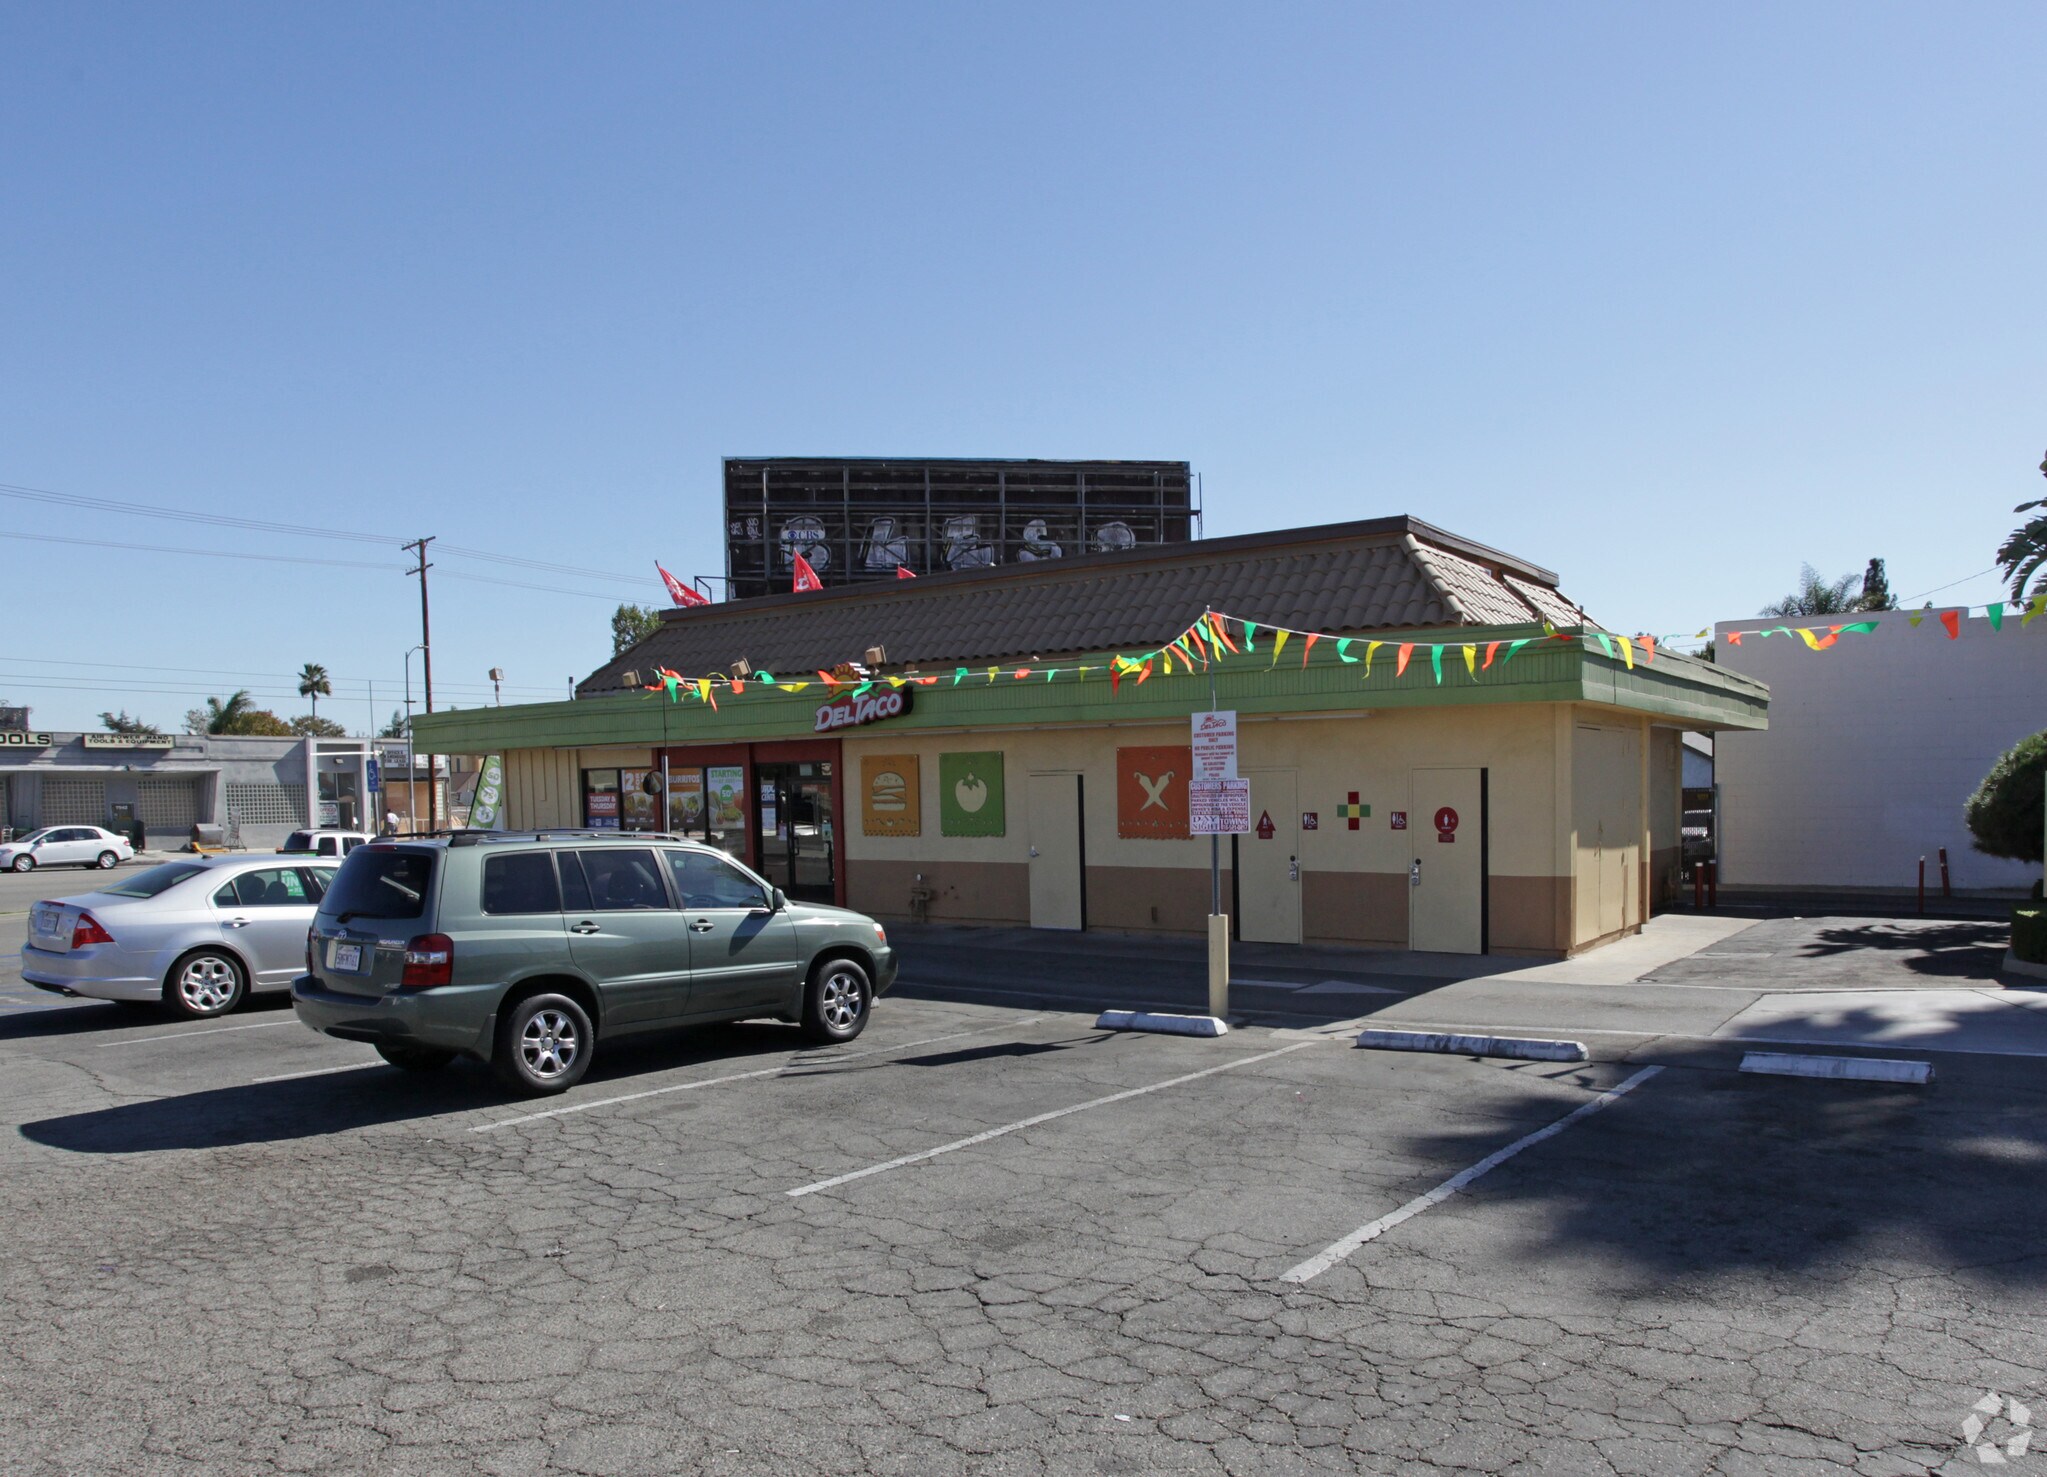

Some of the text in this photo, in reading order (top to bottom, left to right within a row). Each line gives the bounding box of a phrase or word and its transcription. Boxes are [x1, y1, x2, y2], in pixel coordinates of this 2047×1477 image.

[798, 530, 820, 539] CBS
[814, 693, 902, 731] DEL TACO
[711, 769, 742, 778] STARTING
[625, 773, 635, 791] 2
[668, 775, 700, 784] BURRITOS
[590, 795, 610, 803] TUESDAY
[590, 802, 616, 810] THURSDAY
